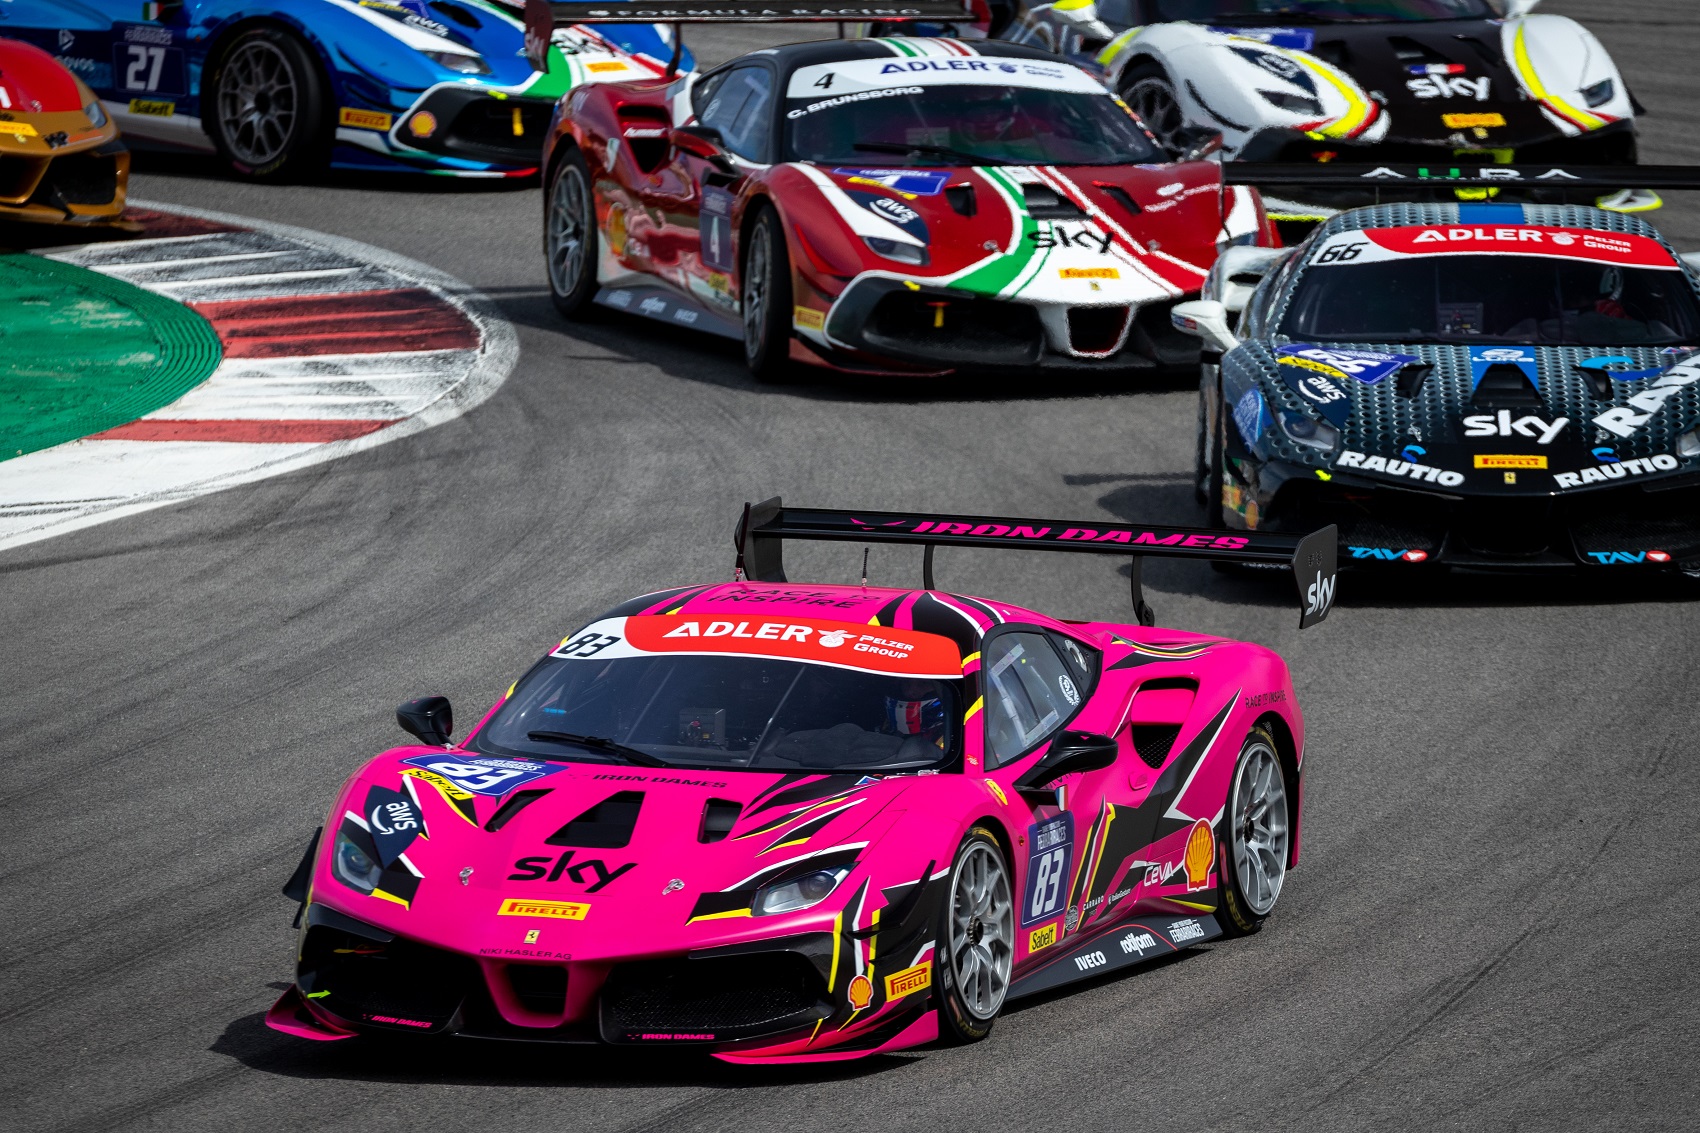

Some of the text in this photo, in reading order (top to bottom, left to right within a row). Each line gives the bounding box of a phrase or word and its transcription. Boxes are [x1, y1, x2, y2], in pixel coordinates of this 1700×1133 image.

[126, 45, 166, 91] 27
[880, 60, 991, 74] ADLER
[813, 72, 835, 90] 4
[1406, 74, 1490, 100] sky
[806, 85, 925, 114] BRUNSBORG
[876, 198, 919, 221] aws
[1027, 226, 1114, 253] sky
[1413, 229, 1545, 245] ADLER
[1317, 242, 1370, 264] 66
[1306, 376, 1347, 400] aws
[1463, 409, 1570, 444] sky
[1336, 450, 1465, 488] RAUTIO
[1482, 457, 1540, 467] PIRELLI
[1553, 454, 1680, 489] RAUTIO
[910, 520, 1250, 551] IRON DAMES
[706, 595, 863, 609] INSPIRE
[729, 589, 837, 598] RACE
[1305, 569, 1336, 617] sky
[661, 621, 814, 643] ADLER
[858, 634, 915, 652] PELZER
[560, 632, 621, 658] 83
[853, 642, 909, 660] GROUP
[427, 762, 524, 790] 83
[593, 774, 728, 789] IRON DAMES
[385, 801, 418, 831] aws
[507, 850, 640, 894] sky
[1031, 848, 1065, 917] 83
[507, 901, 581, 917] PIRELLI
[1031, 927, 1054, 951] Sabelt
[1119, 932, 1157, 956] rotiform
[505, 949, 552, 958] HASLER
[554, 952, 573, 961] AG
[1074, 950, 1107, 971] IVECO
[889, 967, 928, 996] PIRELLI
[371, 1015, 432, 1028] IRON DAMES
